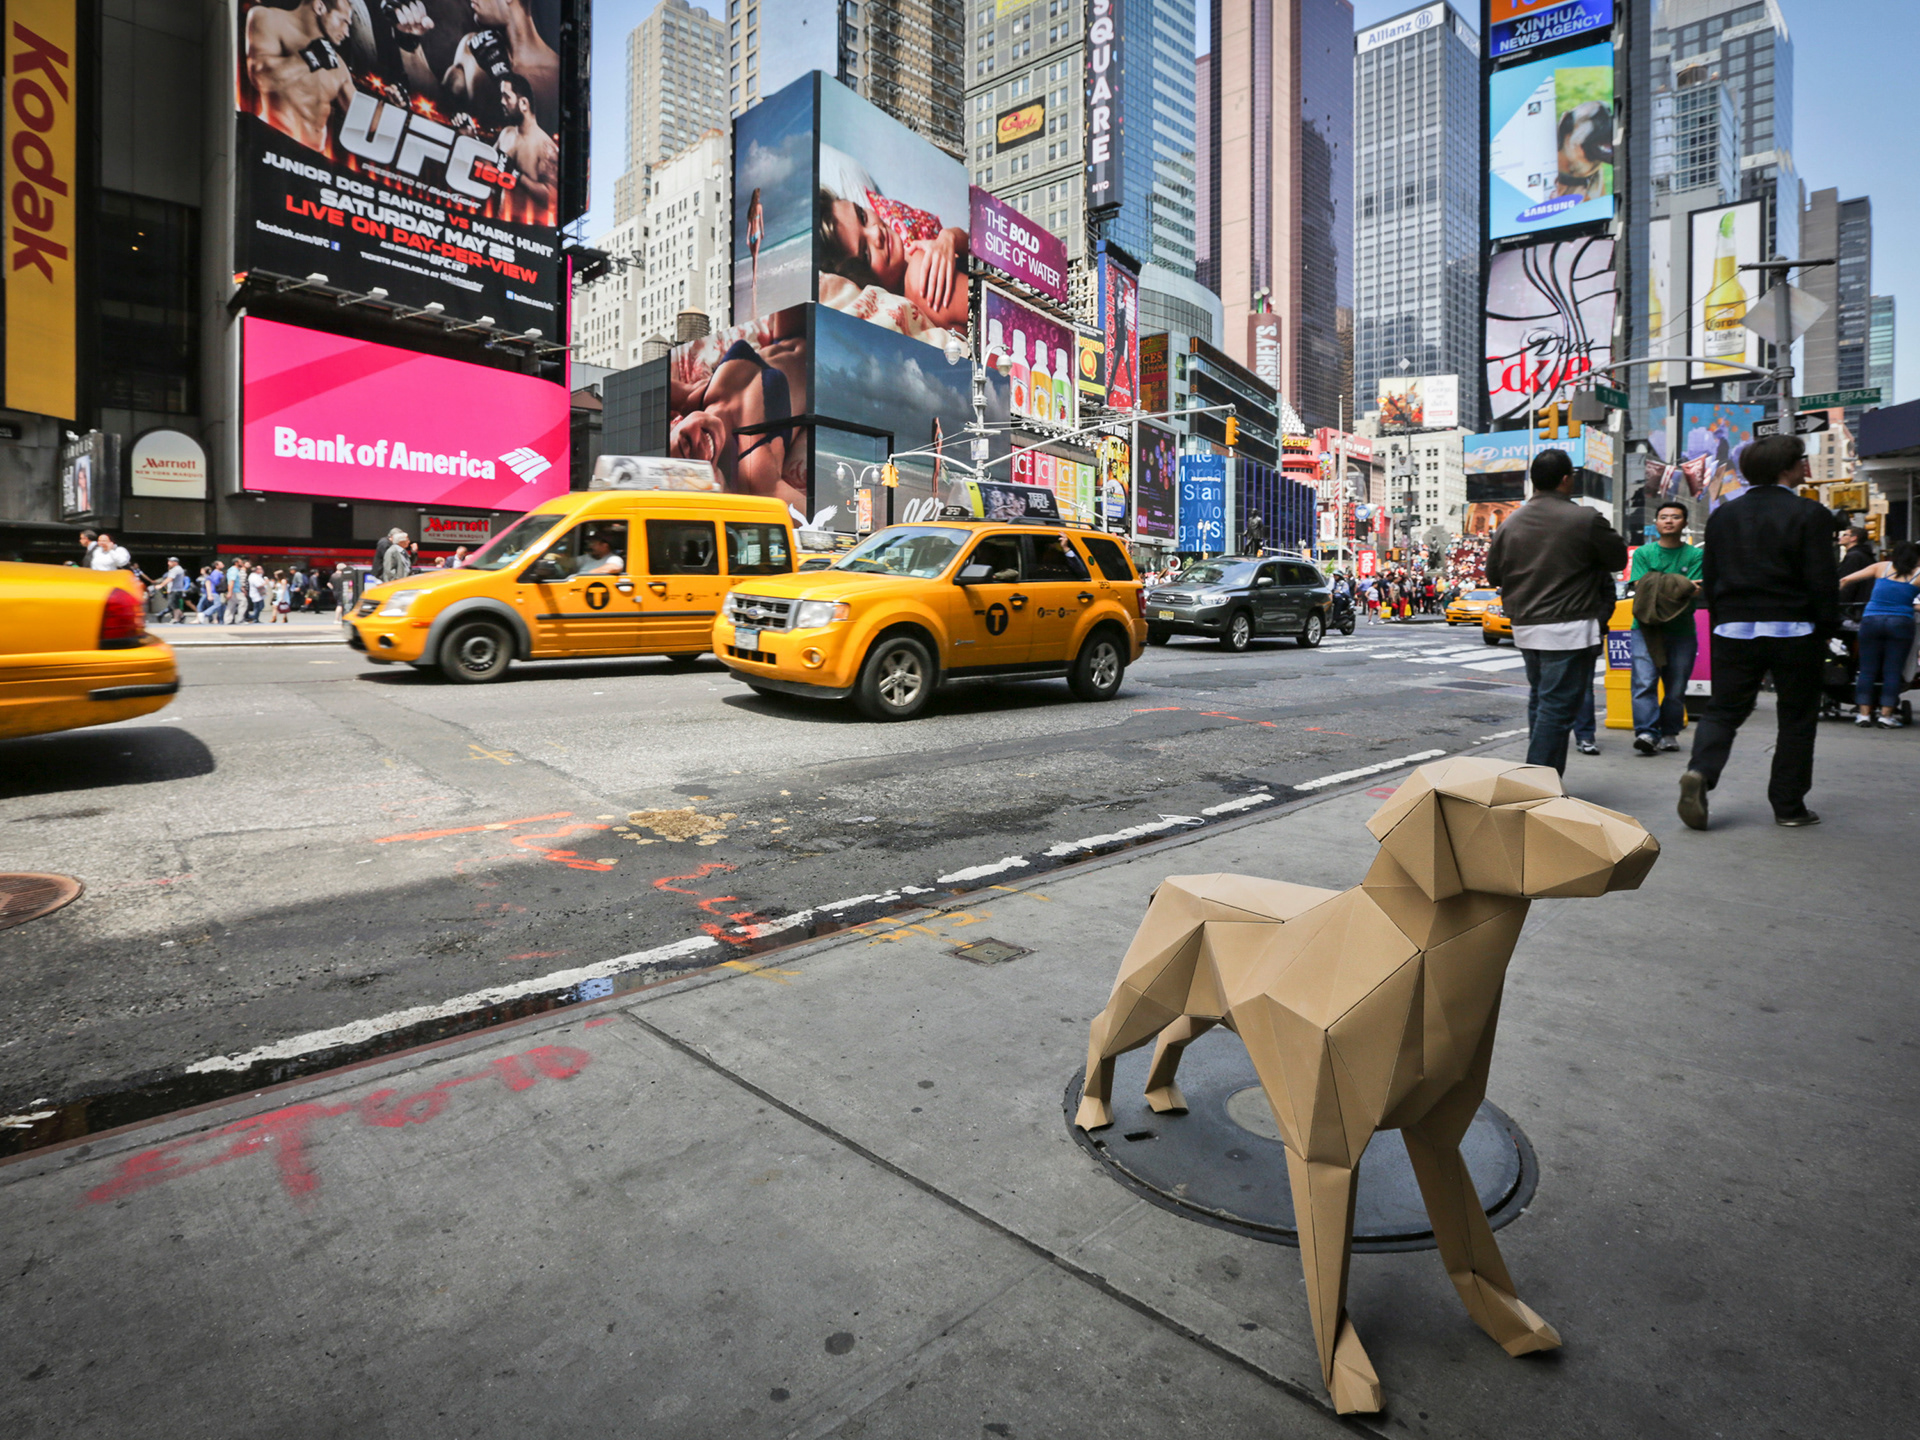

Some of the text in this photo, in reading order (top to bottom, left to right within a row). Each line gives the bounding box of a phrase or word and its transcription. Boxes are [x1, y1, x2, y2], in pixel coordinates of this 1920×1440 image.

[1500, 31, 1541, 52] NEWS
[1542, 12, 1604, 39] AGENCY
[1515, 4, 1587, 36] XINHUA
[1367, 21, 1413, 46] Allianz
[1089, 0, 1114, 164] SQUARE
[12, 20, 69, 285] Kodak
[339, 90, 516, 200] UFC 160
[362, 163, 415, 187] PRESENTED
[415, 181, 429, 190] BY
[1092, 180, 1110, 193] NYC
[262, 151, 554, 258] JUNIOR DOS SANTOS VS MARK HUNT
[1524, 199, 1576, 218] SAMSUNG
[320, 188, 515, 263] SATURDAY MAY 25
[985, 207, 1040, 254] THE BOLD
[286, 194, 538, 284] LIVE ON PAY-PER-VIEW
[985, 231, 1060, 289] SIDE OF WATER
[1705, 318, 1741, 331] Coron
[1078, 336, 1104, 354] venue
[1528, 334, 1595, 356] Diet
[1080, 349, 1097, 380] Q
[1256, 325, 1277, 390] RSHEY'S
[1840, 387, 1880, 402] BRAZIL
[142, 457, 197, 470] Marriott
[274, 426, 496, 480] Bank of America
[1014, 453, 1034, 477] ICE
[1037, 458, 1055, 481] ICE
[1059, 463, 1075, 486] ICE
[1027, 491, 1048, 502] TEEN
[1029, 498, 1051, 510] WOLF
[1184, 484, 1221, 501] Stan
[424, 517, 489, 533] Marriott
[991, 609, 1004, 632] T
